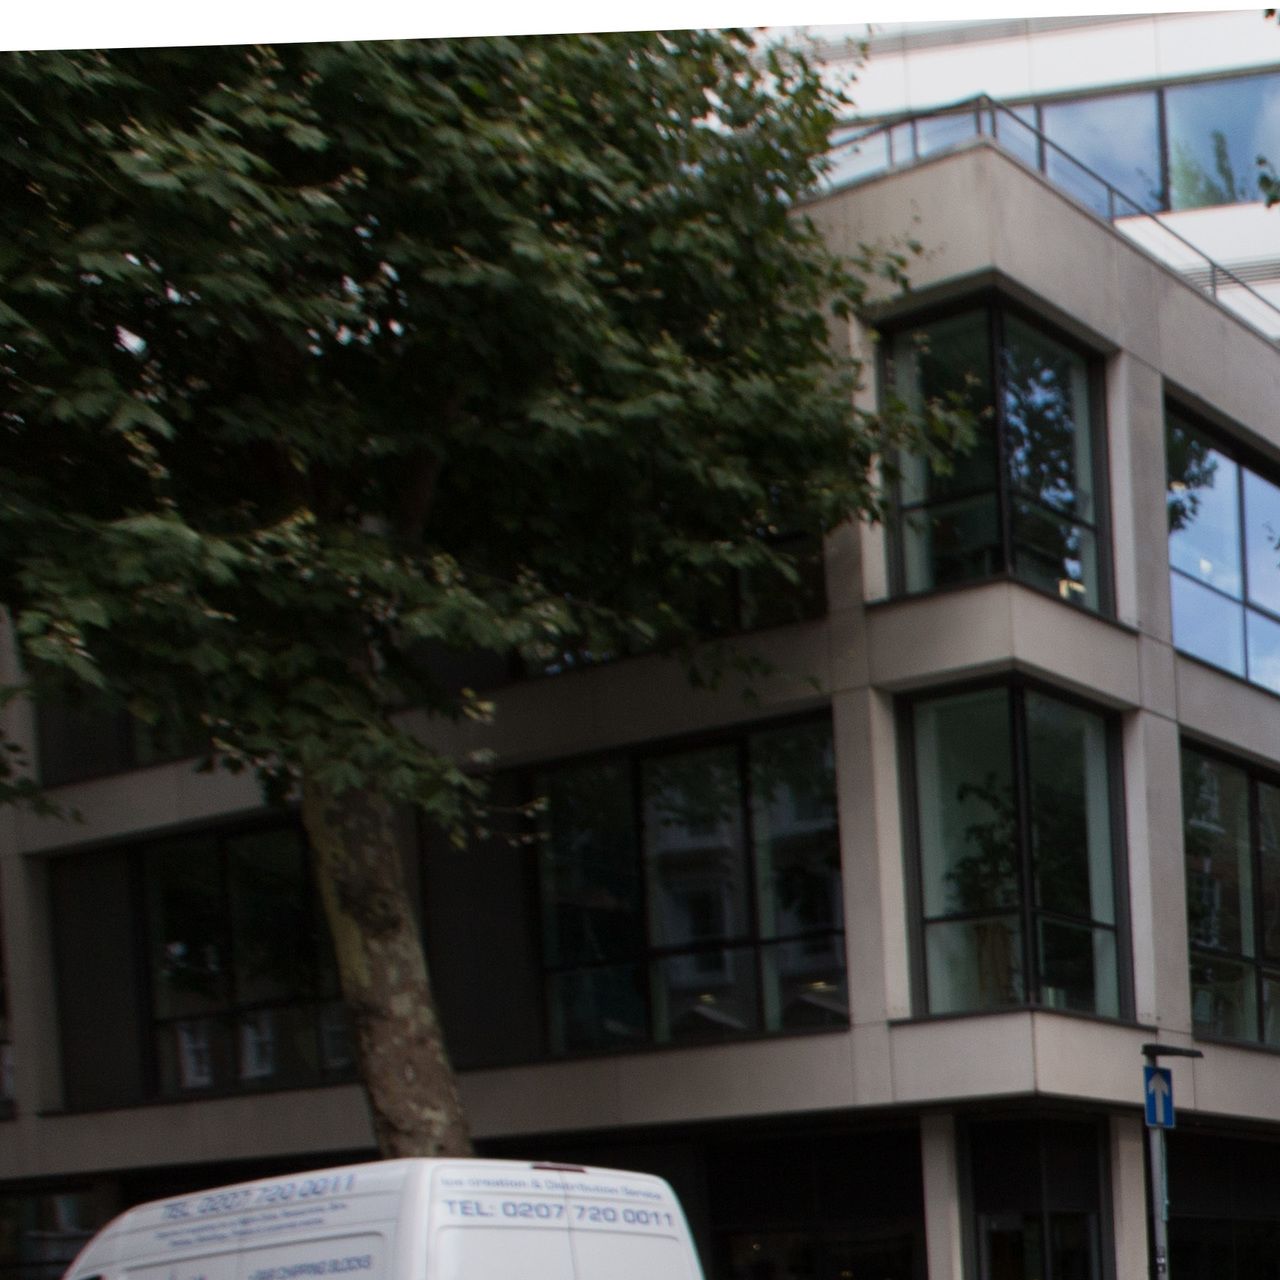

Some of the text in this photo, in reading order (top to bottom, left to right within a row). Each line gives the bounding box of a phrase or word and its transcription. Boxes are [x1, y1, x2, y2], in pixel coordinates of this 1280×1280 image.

[501, 1201, 566, 1219] 0207
[574, 1204, 617, 1223] 720
[622, 1208, 674, 1227] 0011
